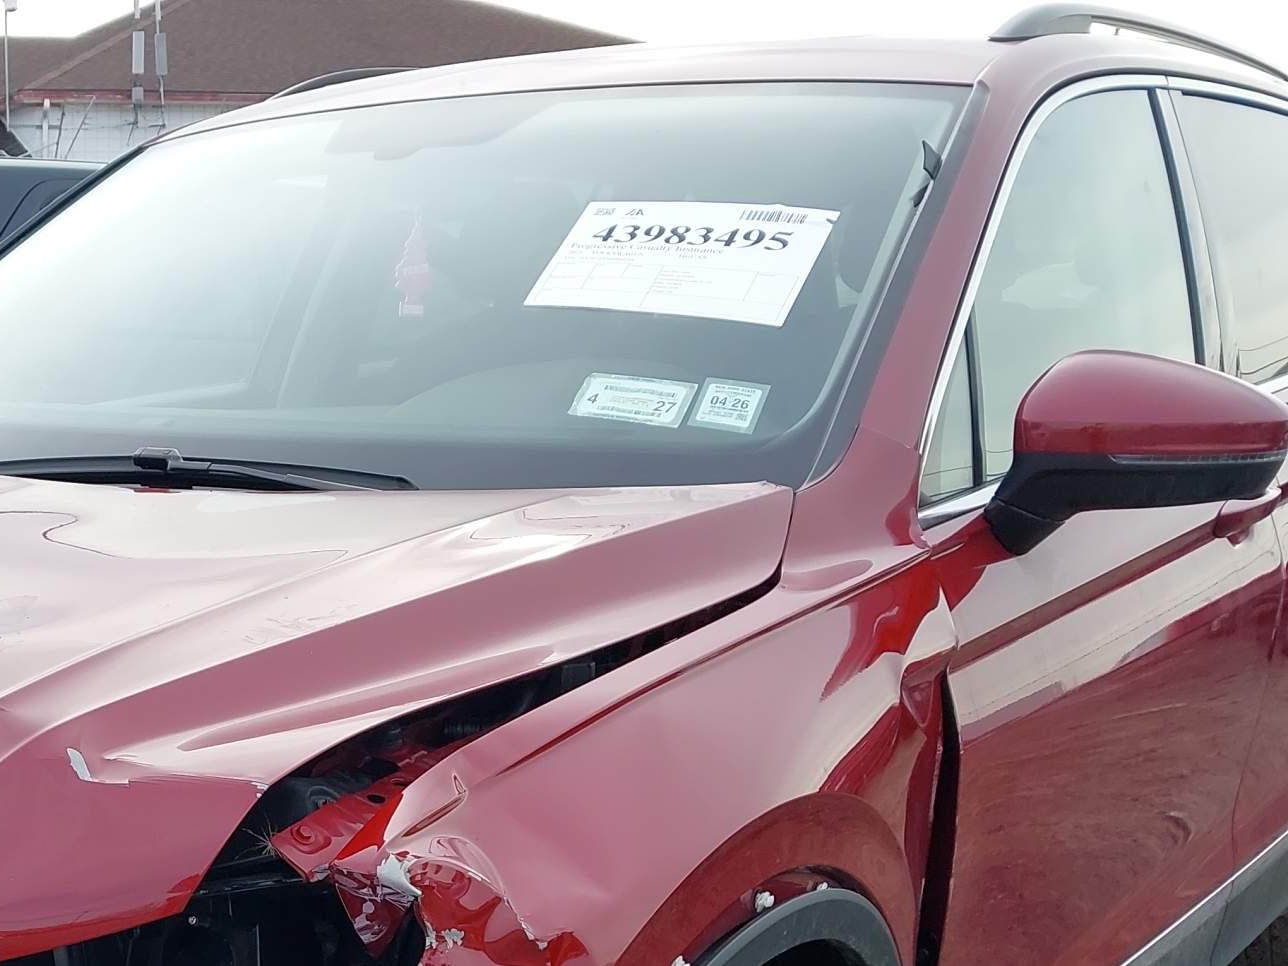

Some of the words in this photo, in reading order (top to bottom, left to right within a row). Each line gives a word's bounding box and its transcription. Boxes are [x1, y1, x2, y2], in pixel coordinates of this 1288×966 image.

[592, 223, 794, 251] 43983495
[587, 393, 599, 405] 4
[653, 400, 677, 413] 27
[710, 396, 727, 406] 04
[732, 398, 750, 409] 26
